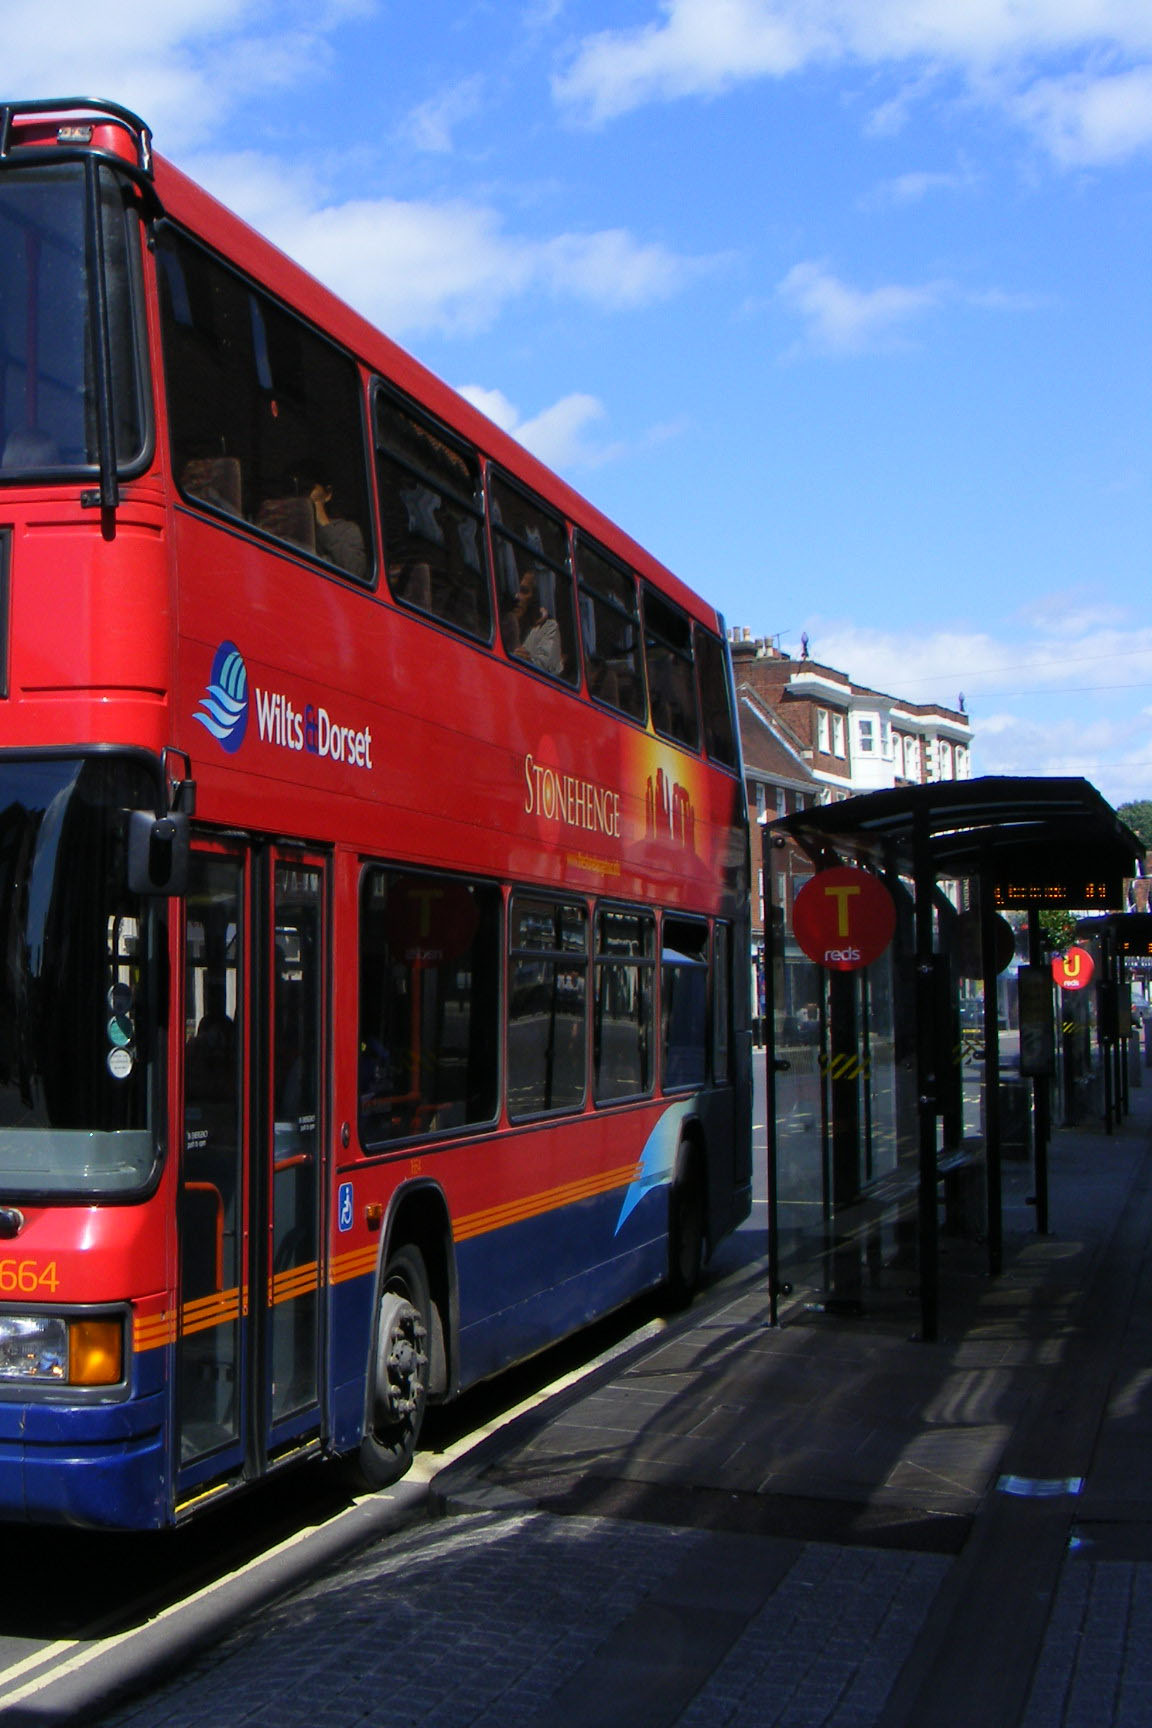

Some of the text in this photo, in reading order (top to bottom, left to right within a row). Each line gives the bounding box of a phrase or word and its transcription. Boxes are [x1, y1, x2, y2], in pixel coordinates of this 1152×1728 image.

[255, 687, 304, 751] Wilts
[318, 707, 373, 770] Dorset
[524, 753, 621, 839] STONEHENGE
[824, 886, 861, 936] T
[824, 946, 861, 962] reds
[1064, 955, 1080, 977] U
